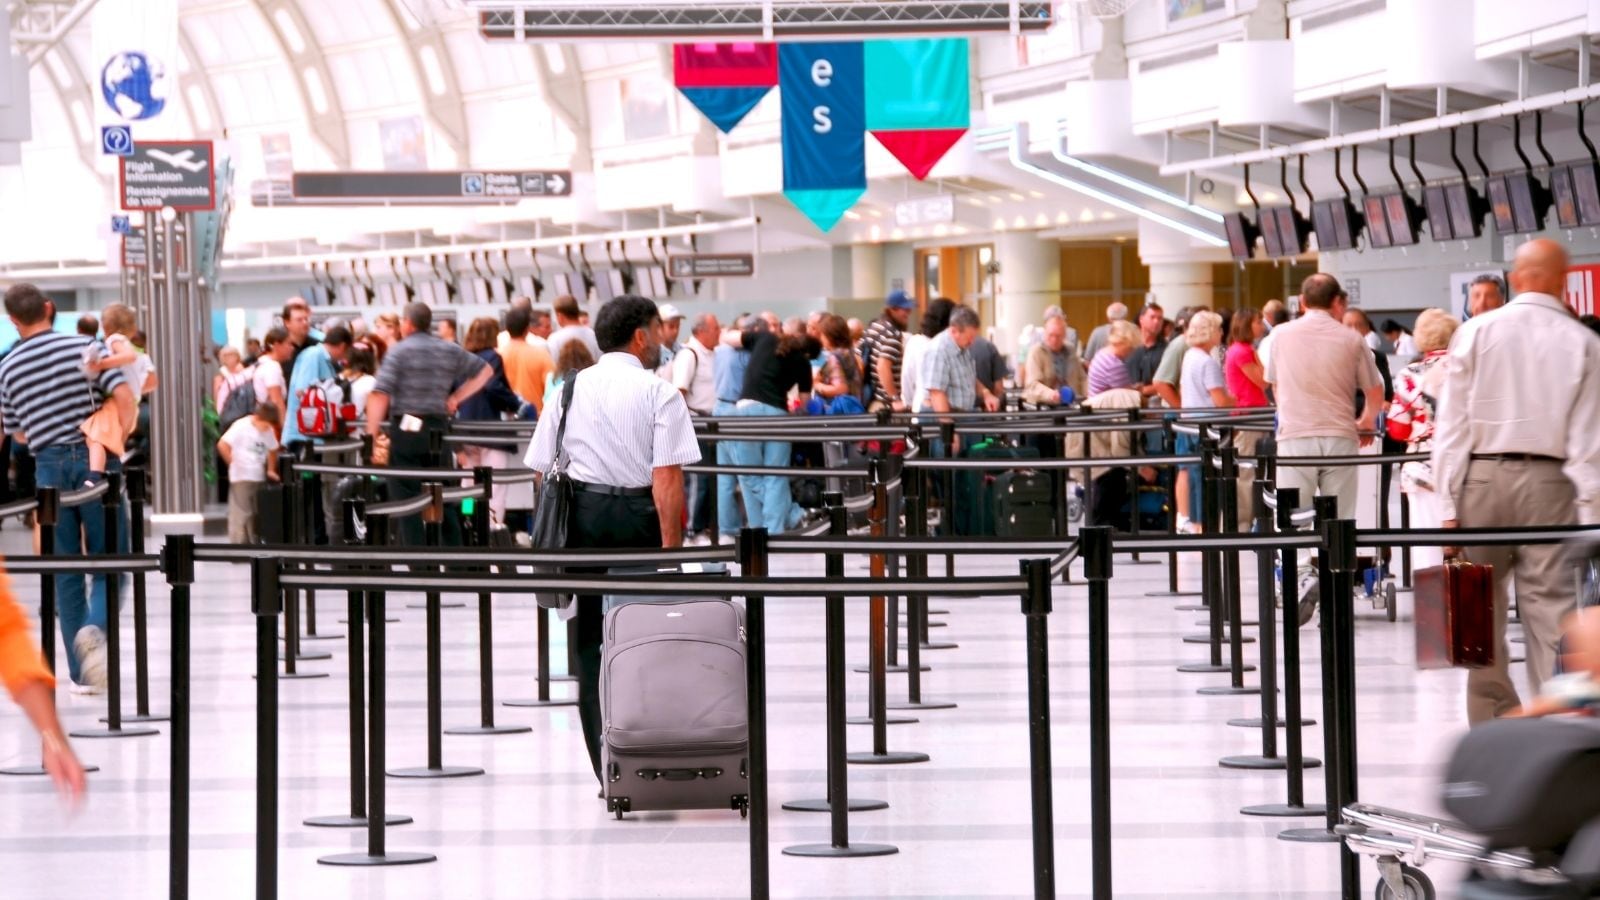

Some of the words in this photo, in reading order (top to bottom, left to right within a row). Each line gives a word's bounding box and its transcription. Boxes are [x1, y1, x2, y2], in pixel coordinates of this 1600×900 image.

[125, 161, 154, 173] Flight
[126, 172, 183, 182] Information
[126, 185, 210, 198] Renseignements
[126, 196, 140, 207] de
